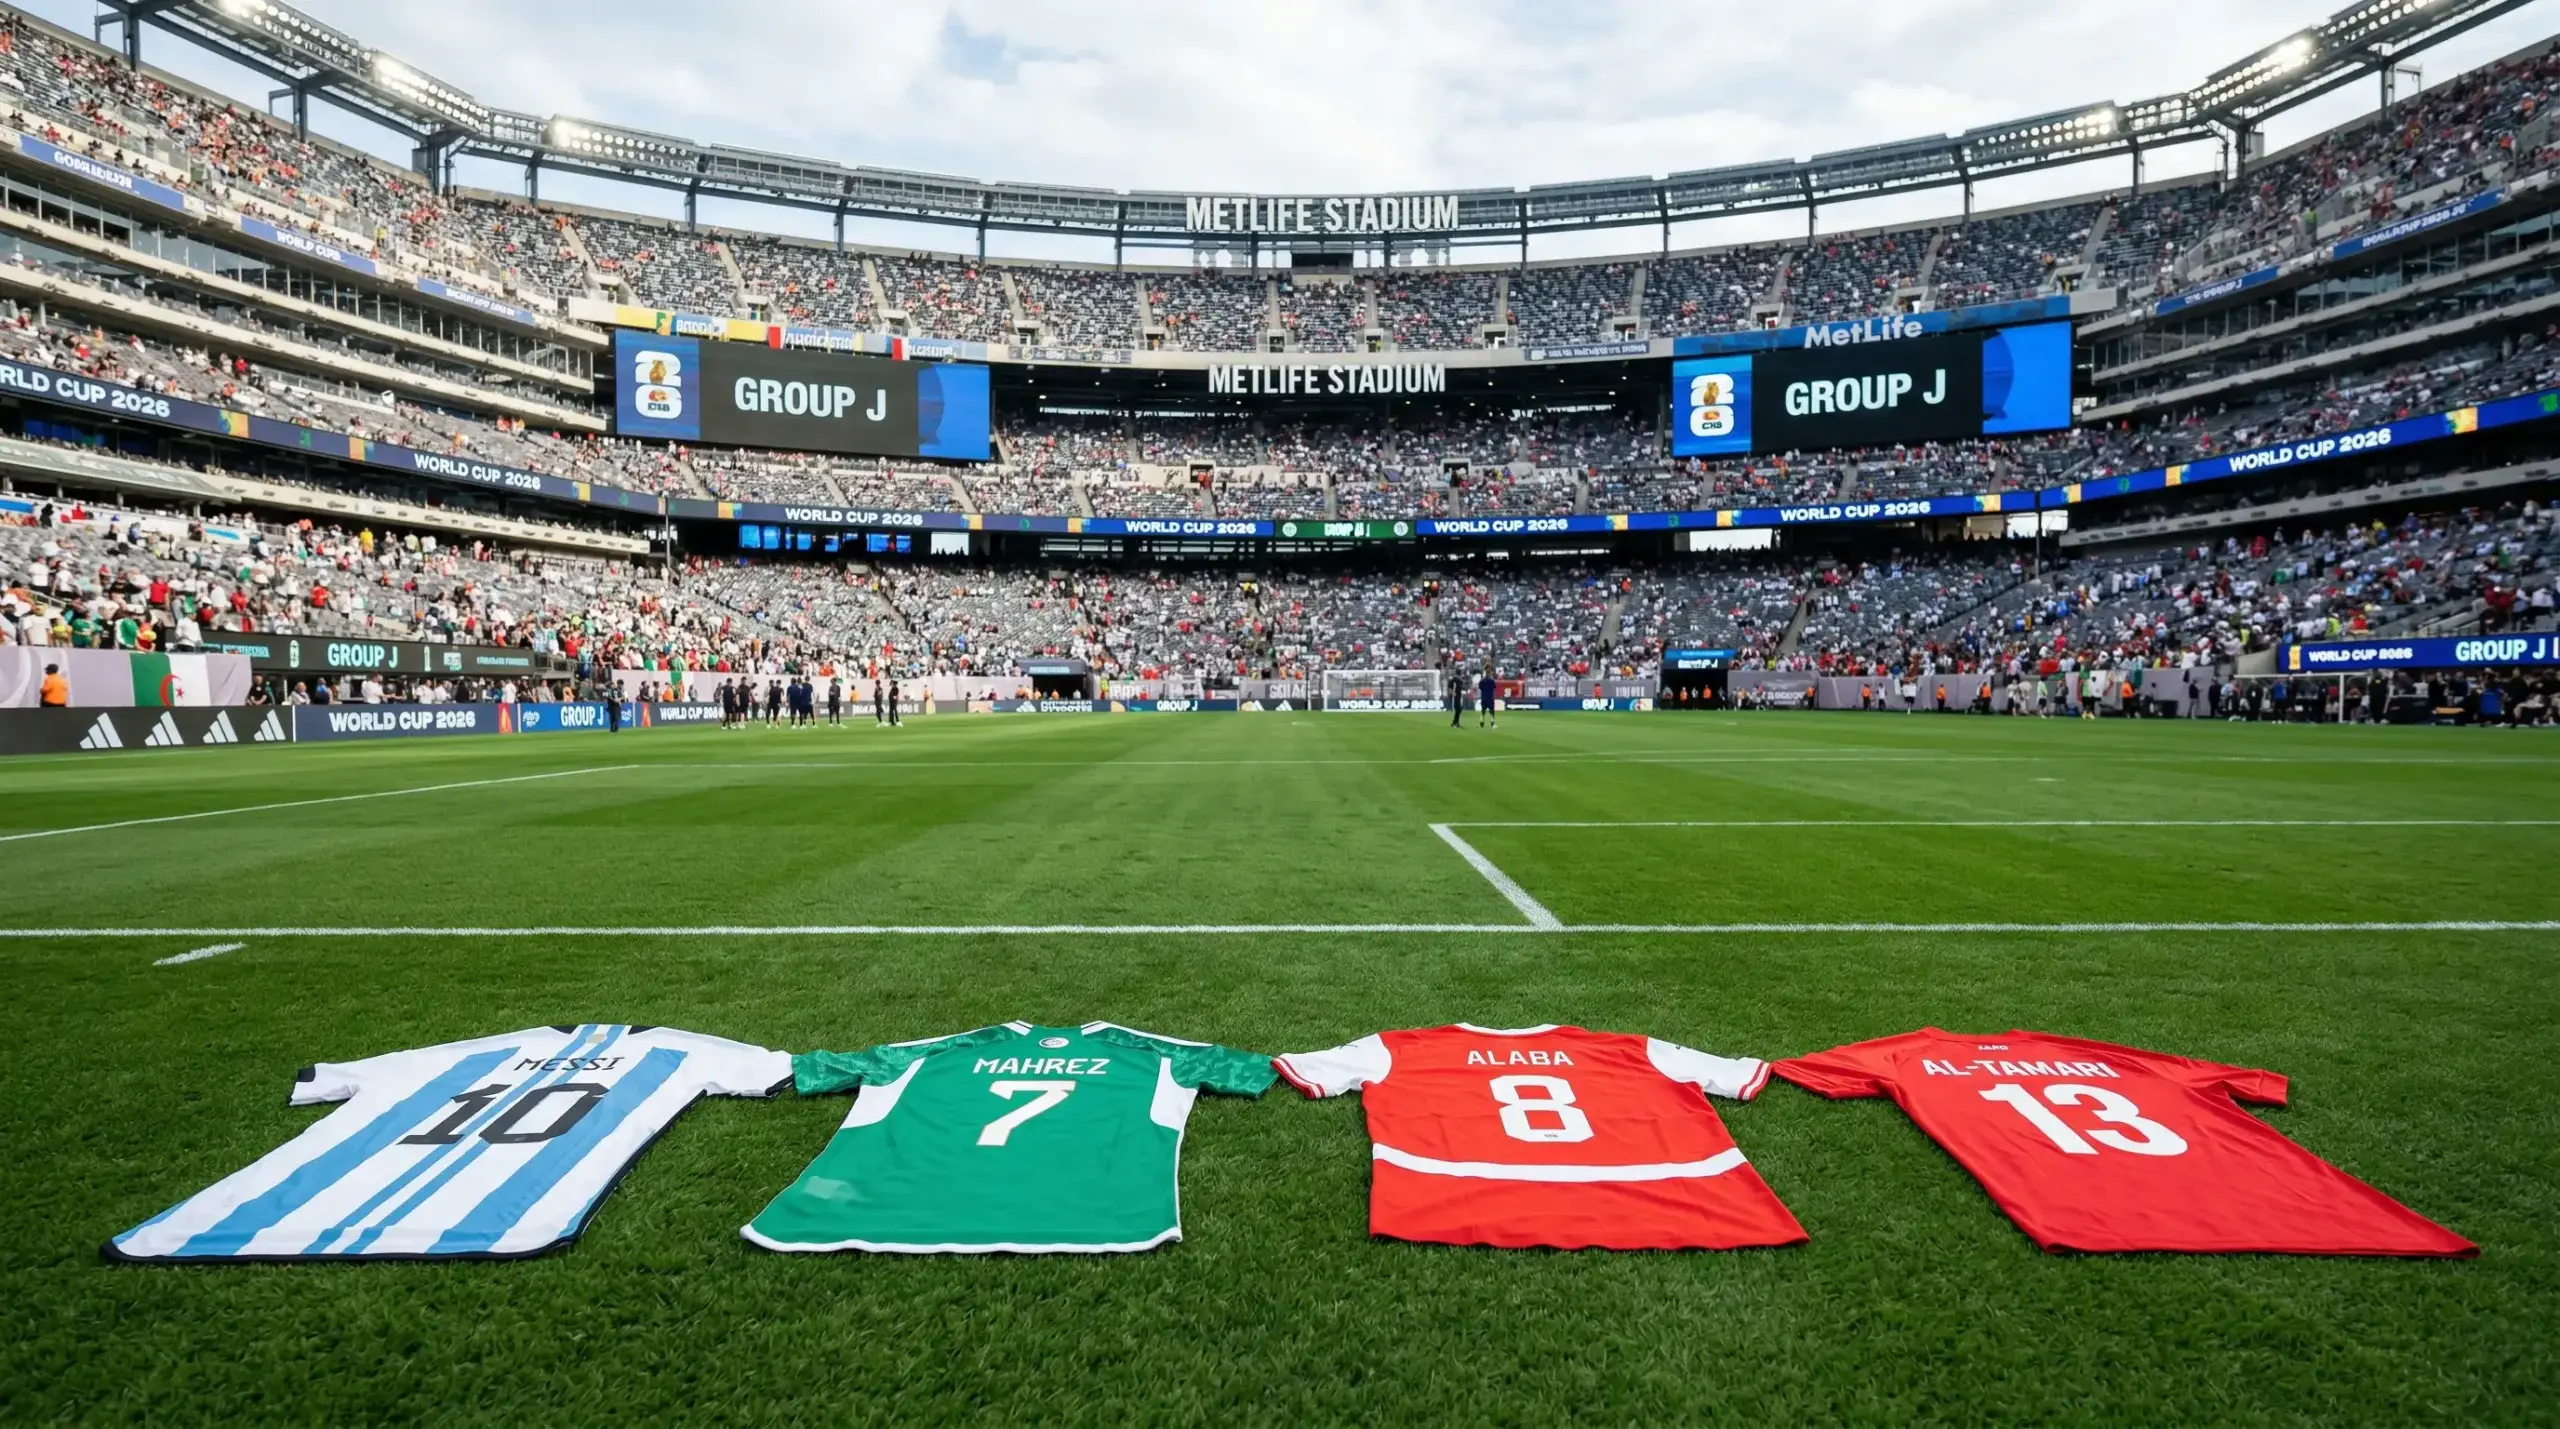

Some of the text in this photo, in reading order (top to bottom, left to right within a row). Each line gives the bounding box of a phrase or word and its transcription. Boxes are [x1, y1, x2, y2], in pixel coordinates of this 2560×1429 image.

[1185, 195, 1459, 231] METLIFE STADIUM
[1804, 317, 1922, 348] MetLife
[1208, 363, 1446, 393] METLIFE STADIUM
[56, 378, 106, 403] CUP
[112, 390, 170, 417] 2026
[735, 377, 886, 421] GROUP J
[1786, 369, 1945, 415] GROUP J
[2230, 428, 2391, 471] WORLD CUP 2026
[414, 453, 541, 490] WORLD CUP 2026
[785, 507, 923, 526] WORLD CUP 2026
[1781, 502, 1930, 521] WORLD CUP 2026
[1126, 521, 1256, 534] WORLD CUP 2026
[1435, 519, 1568, 532] WORLD CUP 2026
[328, 643, 384, 667] GROUP
[389, 646, 397, 668] J
[2309, 650, 2350, 661] WORLD
[2352, 649, 2377, 660] CUP
[2456, 639, 2545, 661] GROUP J
[660, 707, 687, 720] WORLD
[688, 707, 702, 719] CUP
[1157, 701, 1197, 711] GROUP J
[1338, 700, 1382, 710] WORLD
[329, 711, 475, 732] WORLD CUP 2026
[561, 706, 595, 726] GROUP
[598, 706, 603, 725] J
[514, 1057, 624, 1072] MESSI
[973, 1058, 1110, 1074] MAHREZ
[1468, 1051, 1573, 1065] ALABA
[1922, 1060, 2120, 1077] AL-TAMARI
[396, 1083, 609, 1145] 10
[977, 1081, 1076, 1146] 7
[1490, 1075, 1594, 1142] 8
[1979, 1084, 2187, 1155] 13
